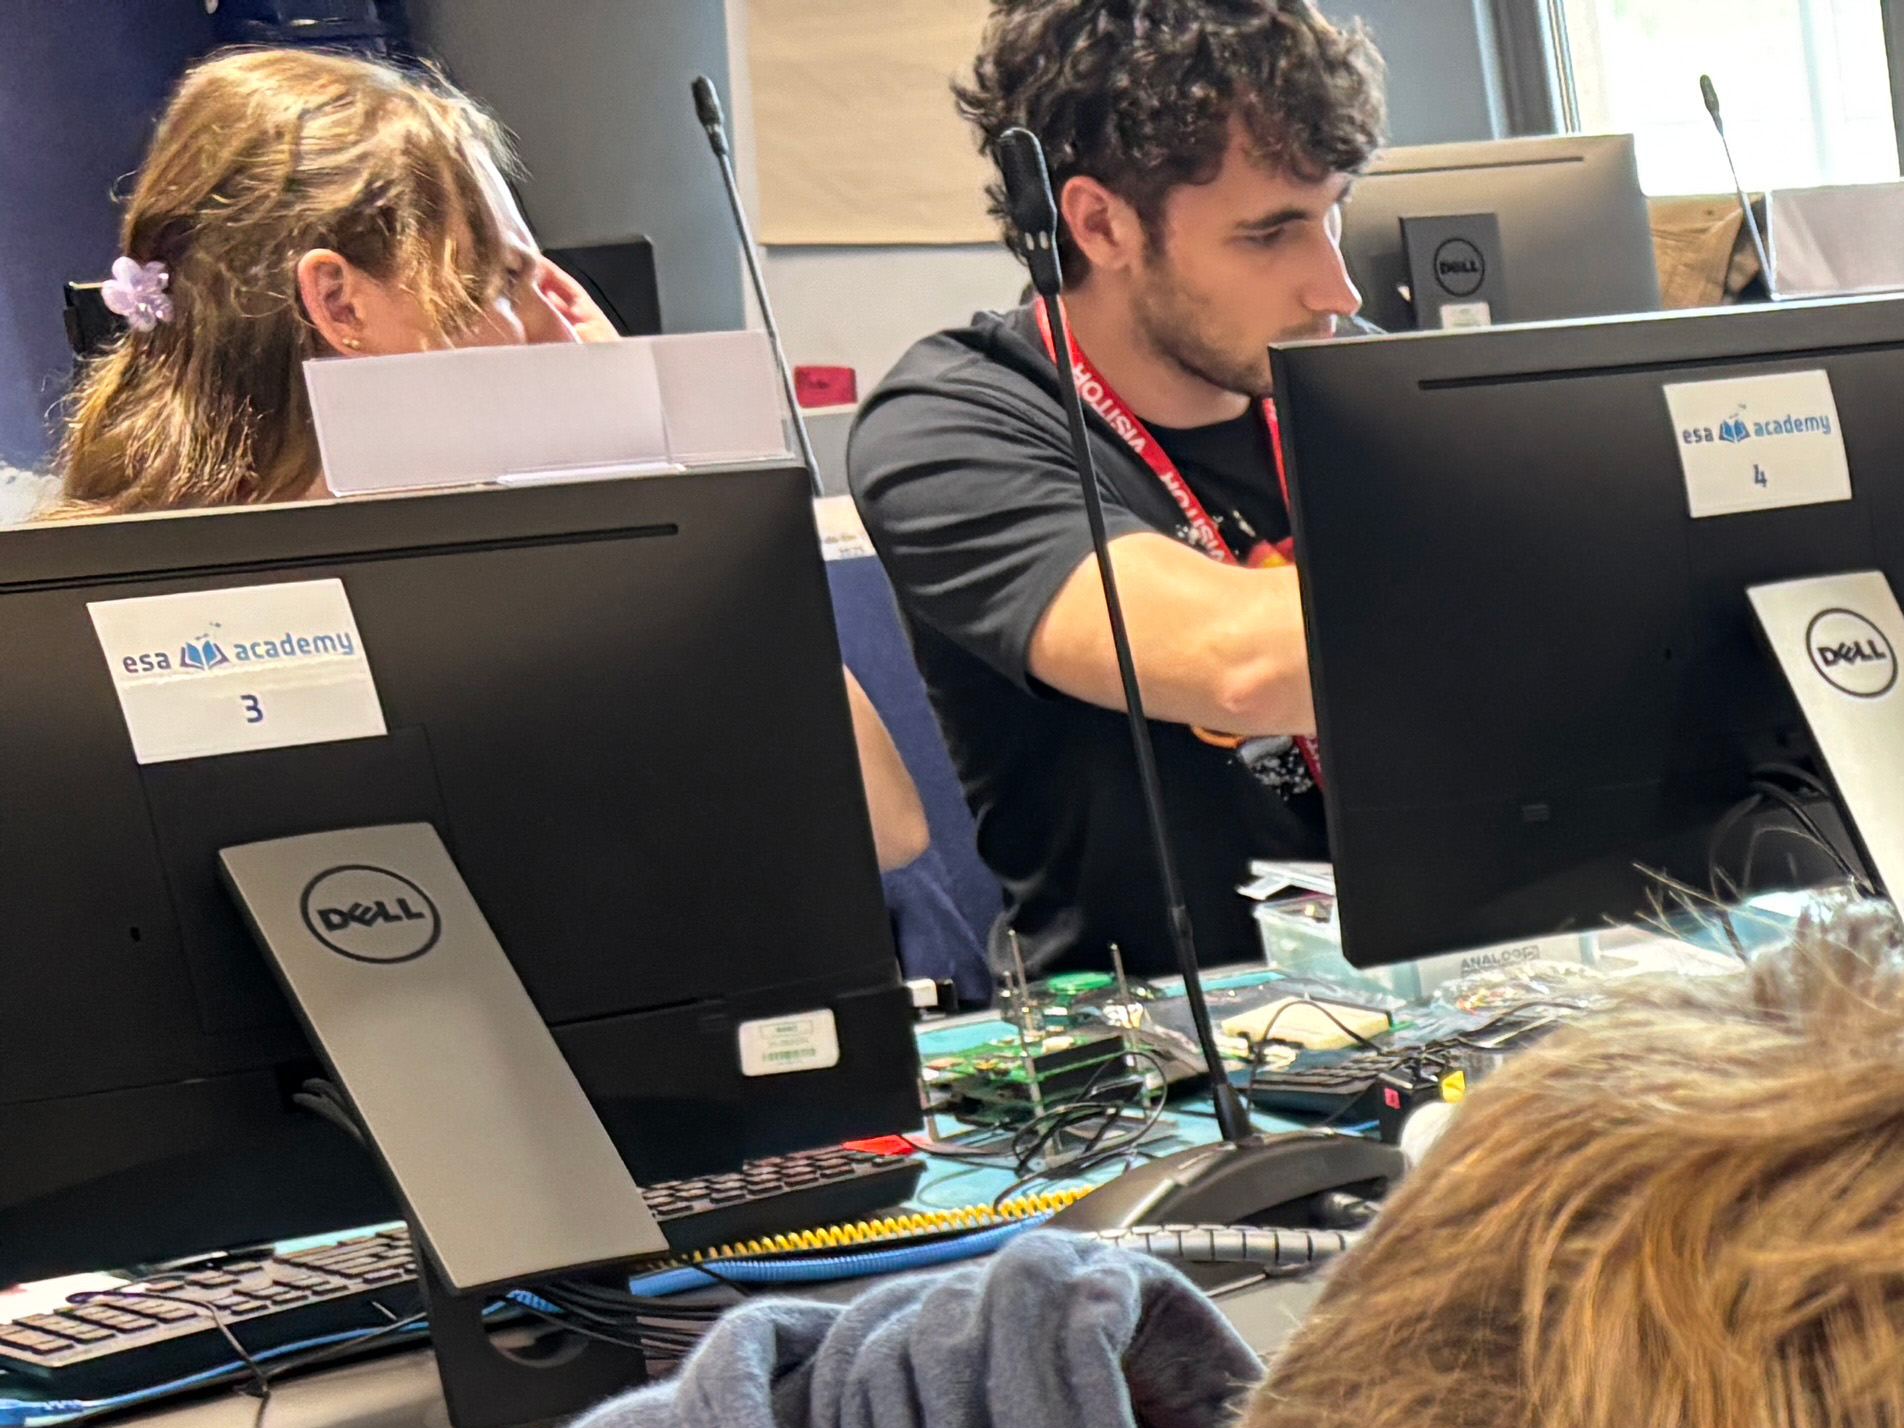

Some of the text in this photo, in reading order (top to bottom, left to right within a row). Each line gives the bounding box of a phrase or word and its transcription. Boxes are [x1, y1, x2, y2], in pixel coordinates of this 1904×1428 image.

[1070, 361, 1146, 454] VISITOR
[1682, 413, 1831, 444] esa academy
[1753, 464, 1768, 488] 4
[122, 632, 355, 673] esa academy
[1817, 639, 1887, 667] DELL
[240, 694, 264, 724] 3
[315, 897, 426, 933] DELL
